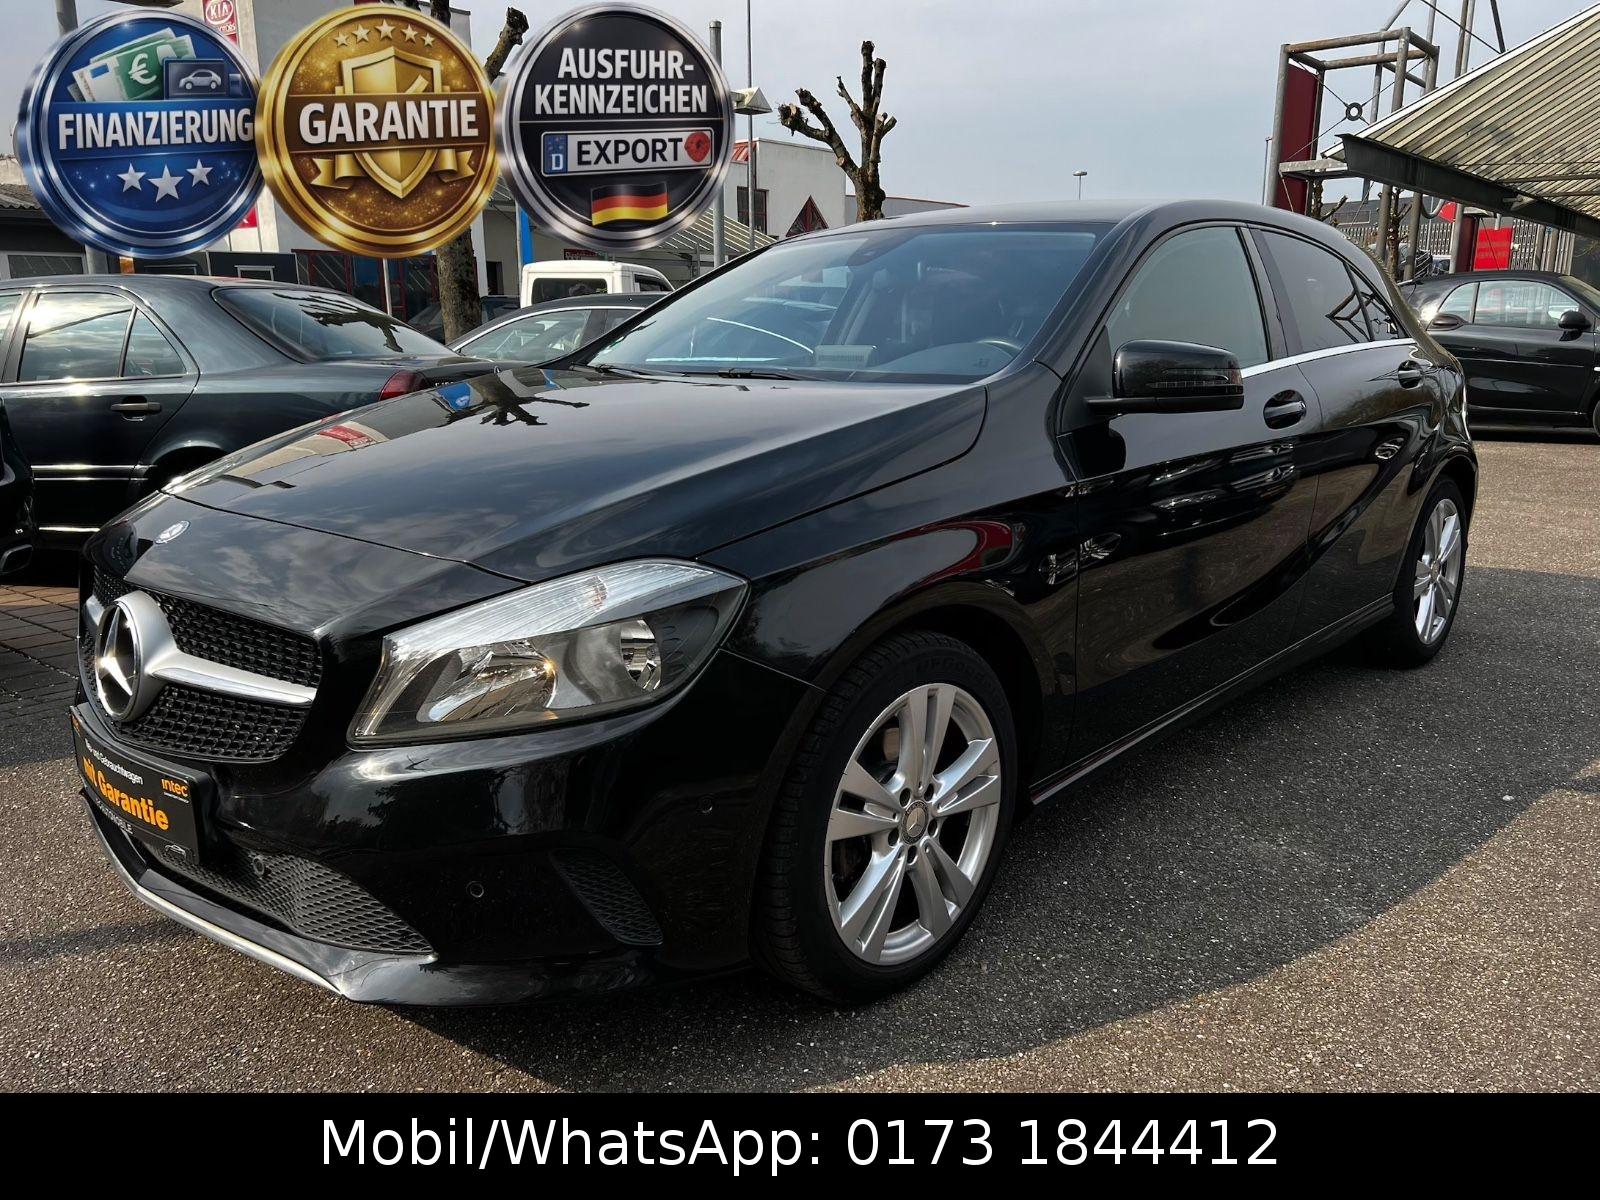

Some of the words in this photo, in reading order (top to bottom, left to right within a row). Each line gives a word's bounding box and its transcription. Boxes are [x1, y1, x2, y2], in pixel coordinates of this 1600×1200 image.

[210, 2, 229, 18] KIA
[161, 778, 189, 797] intec
[98, 770, 169, 831] Garantie
